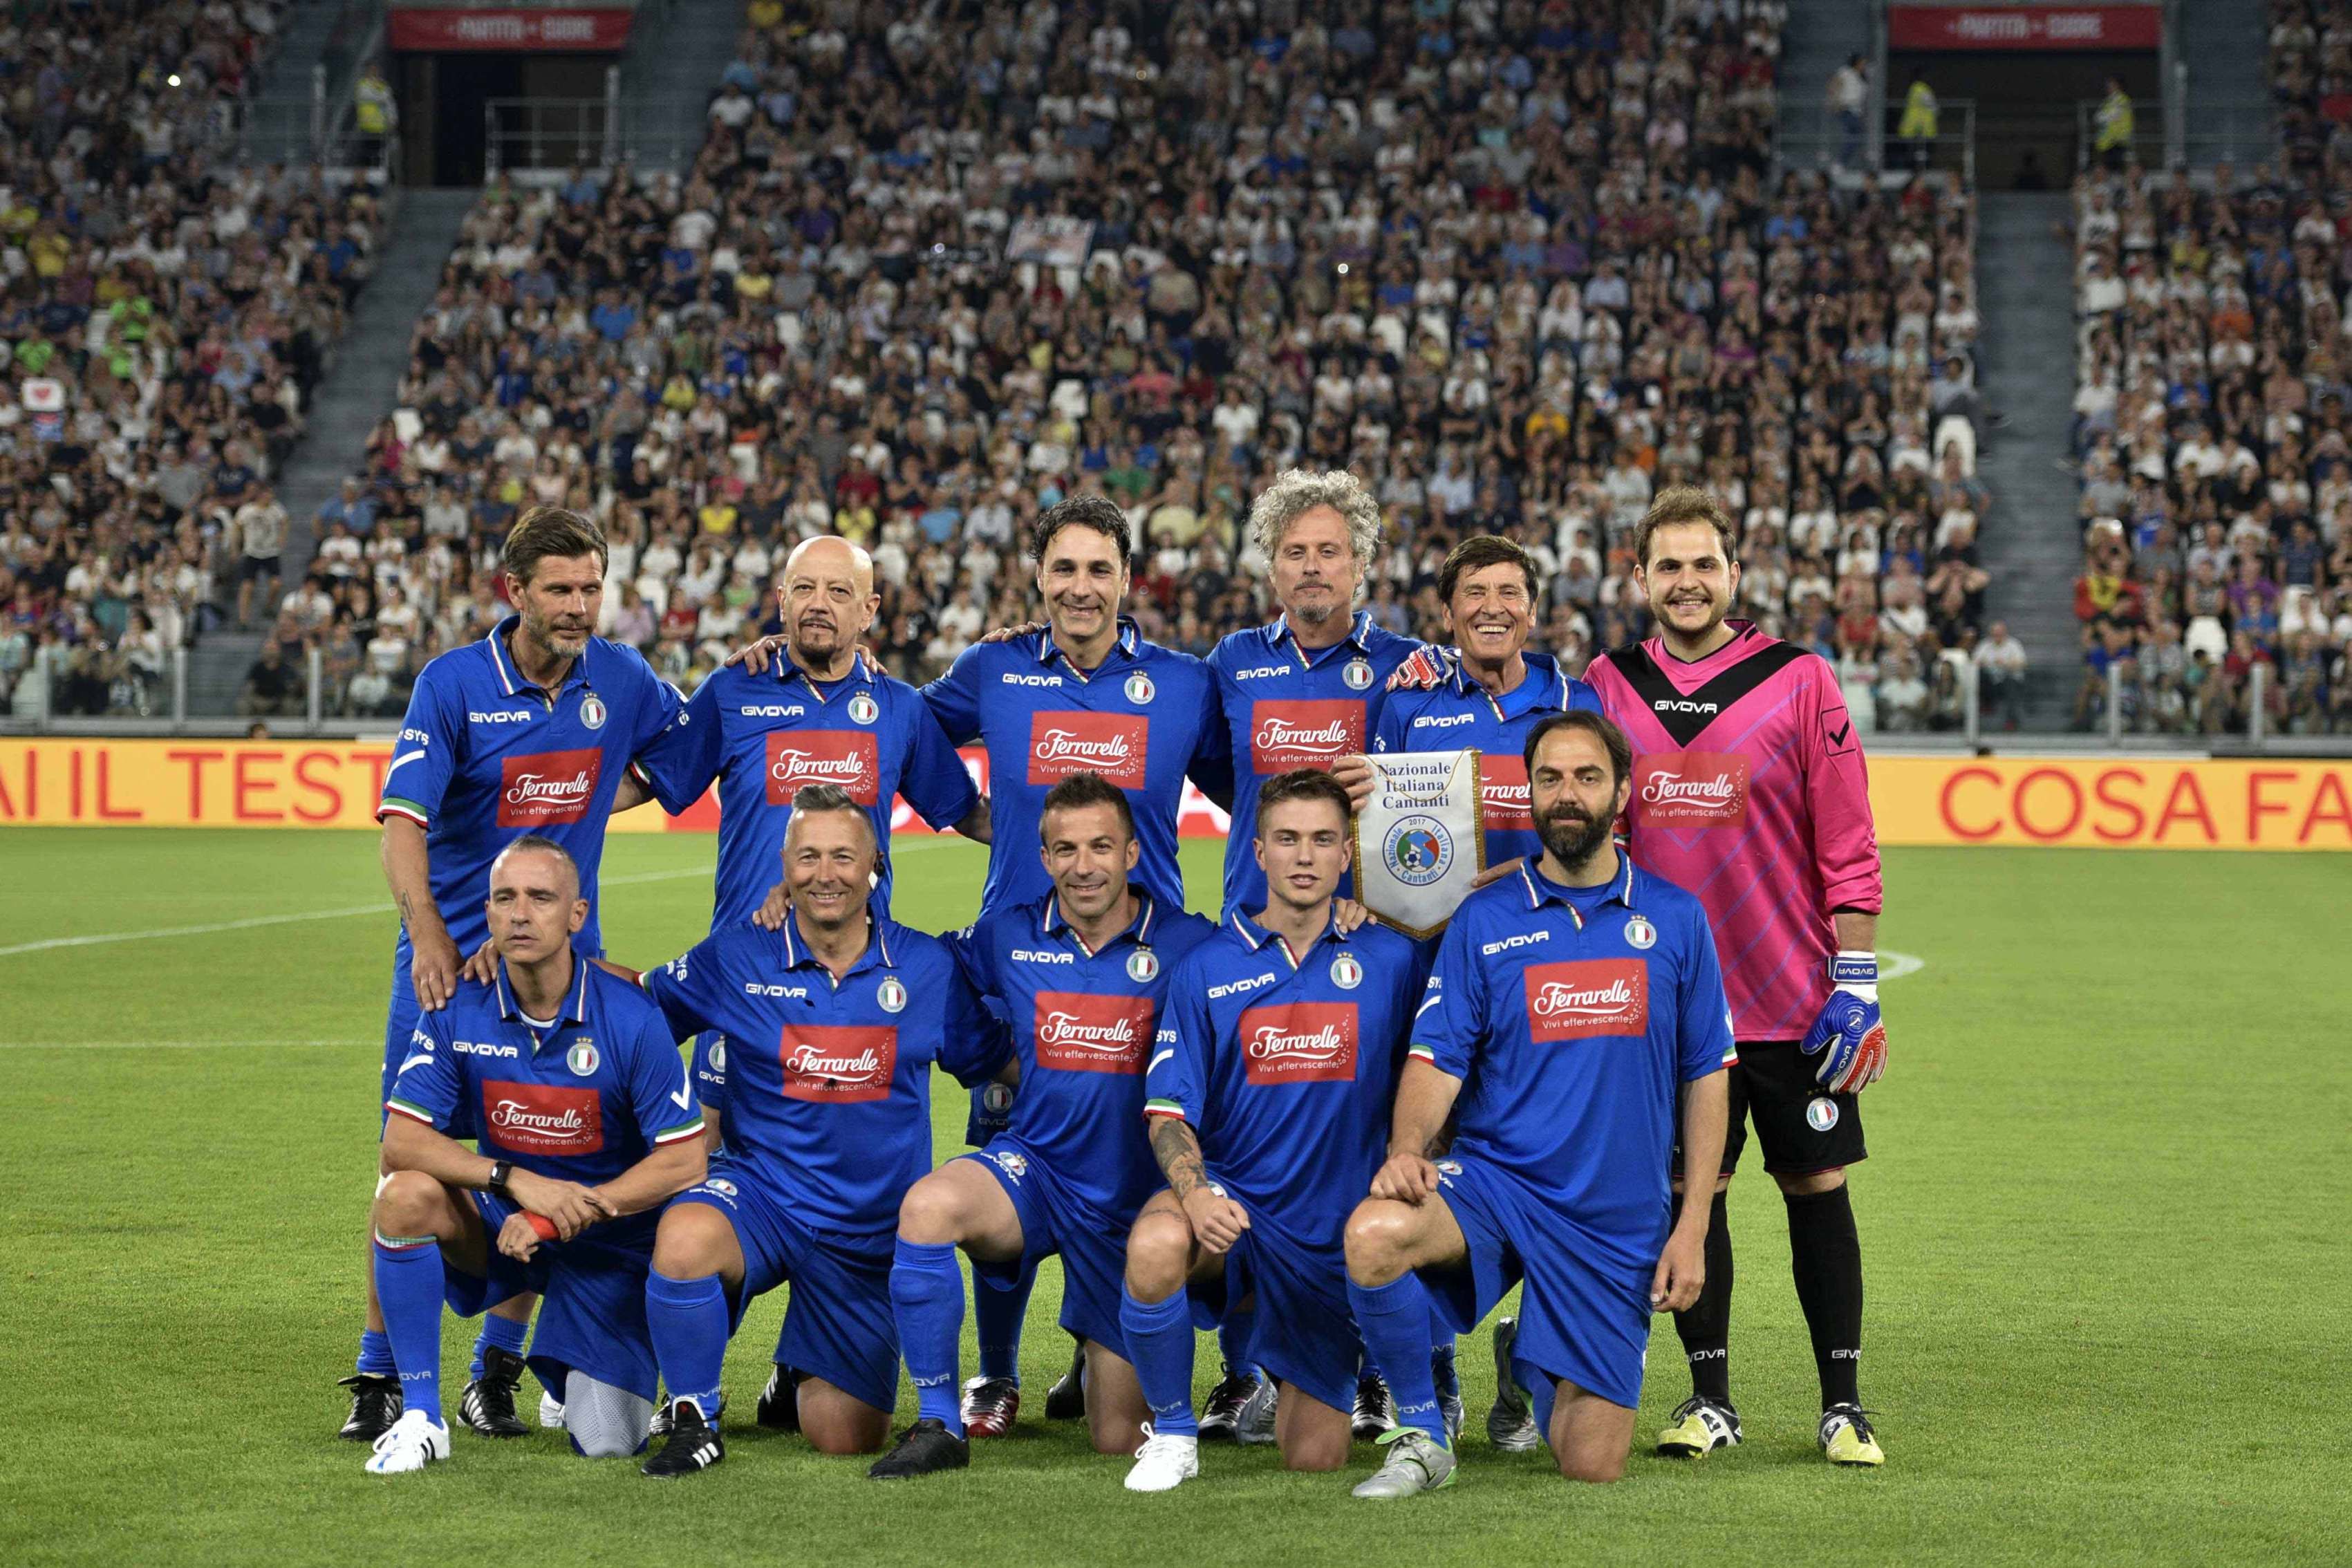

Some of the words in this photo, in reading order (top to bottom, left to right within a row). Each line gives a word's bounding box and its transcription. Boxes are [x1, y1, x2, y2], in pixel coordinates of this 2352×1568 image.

[1002, 673, 1063, 687] GIVOVA
[1236, 666, 1291, 680] GIVOVA
[741, 705, 804, 717] GIVOVA
[1654, 700, 1718, 713] GIVOVA
[469, 711, 530, 723] GIVOVA
[1414, 713, 1475, 728] GIVOVA
[1256, 718, 1347, 749] Ferrarelle
[1036, 729, 1129, 759] Ferrarelle
[772, 749, 864, 780] Ferrarelle
[1262, 754, 1278, 763] Vivi
[1040, 764, 1058, 774] Vivi
[1377, 762, 1451, 777] Nazionale
[71, 749, 142, 821] IL
[167, 749, 393, 823] TEST
[507, 771, 589, 803] Ferrarelle
[778, 785, 796, 794] Vivi
[1385, 779, 1445, 793] Italiana
[1482, 782, 1531, 799] rrarel
[1642, 771, 1734, 803] Ferrarelle
[1382, 794, 1450, 810] Cantanti
[1938, 766, 2219, 844] COSA
[2248, 771, 2352, 846] FA
[511, 808, 526, 816] Vivi
[1484, 809, 1531, 819] ffervescen
[1650, 808, 1666, 817] Vivi
[1669, 808, 1728, 818] effervescente
[1388, 828, 1404, 868] Nazionale
[1401, 868, 1439, 884] Cantanti
[1483, 930, 1549, 955] GIVOVA
[1011, 950, 1074, 964] GIVOVA
[746, 982, 807, 998] GIVOVA
[1208, 972, 1276, 999] GIVOVA
[1534, 979, 1632, 1015] Ferrarelle
[1040, 1011, 1134, 1043] Ferrarelle
[1542, 1020, 1560, 1029] Vivi
[1564, 1016, 1629, 1028] effervescente
[453, 1040, 517, 1058] GIVOVA
[1249, 1025, 1341, 1058] Ferrarelle
[786, 1044, 879, 1073] Ferrarelle
[1045, 1047, 1063, 1057] Vivi
[1065, 1049, 1130, 1062] effervescente
[1258, 1063, 1275, 1073] Vivi
[1278, 1061, 1336, 1072] effervescente
[794, 1079, 811, 1089] Vivi
[492, 1099, 583, 1130] Ferrarelle
[497, 1130, 515, 1140] Vivi
[518, 1134, 584, 1146] effervescente
